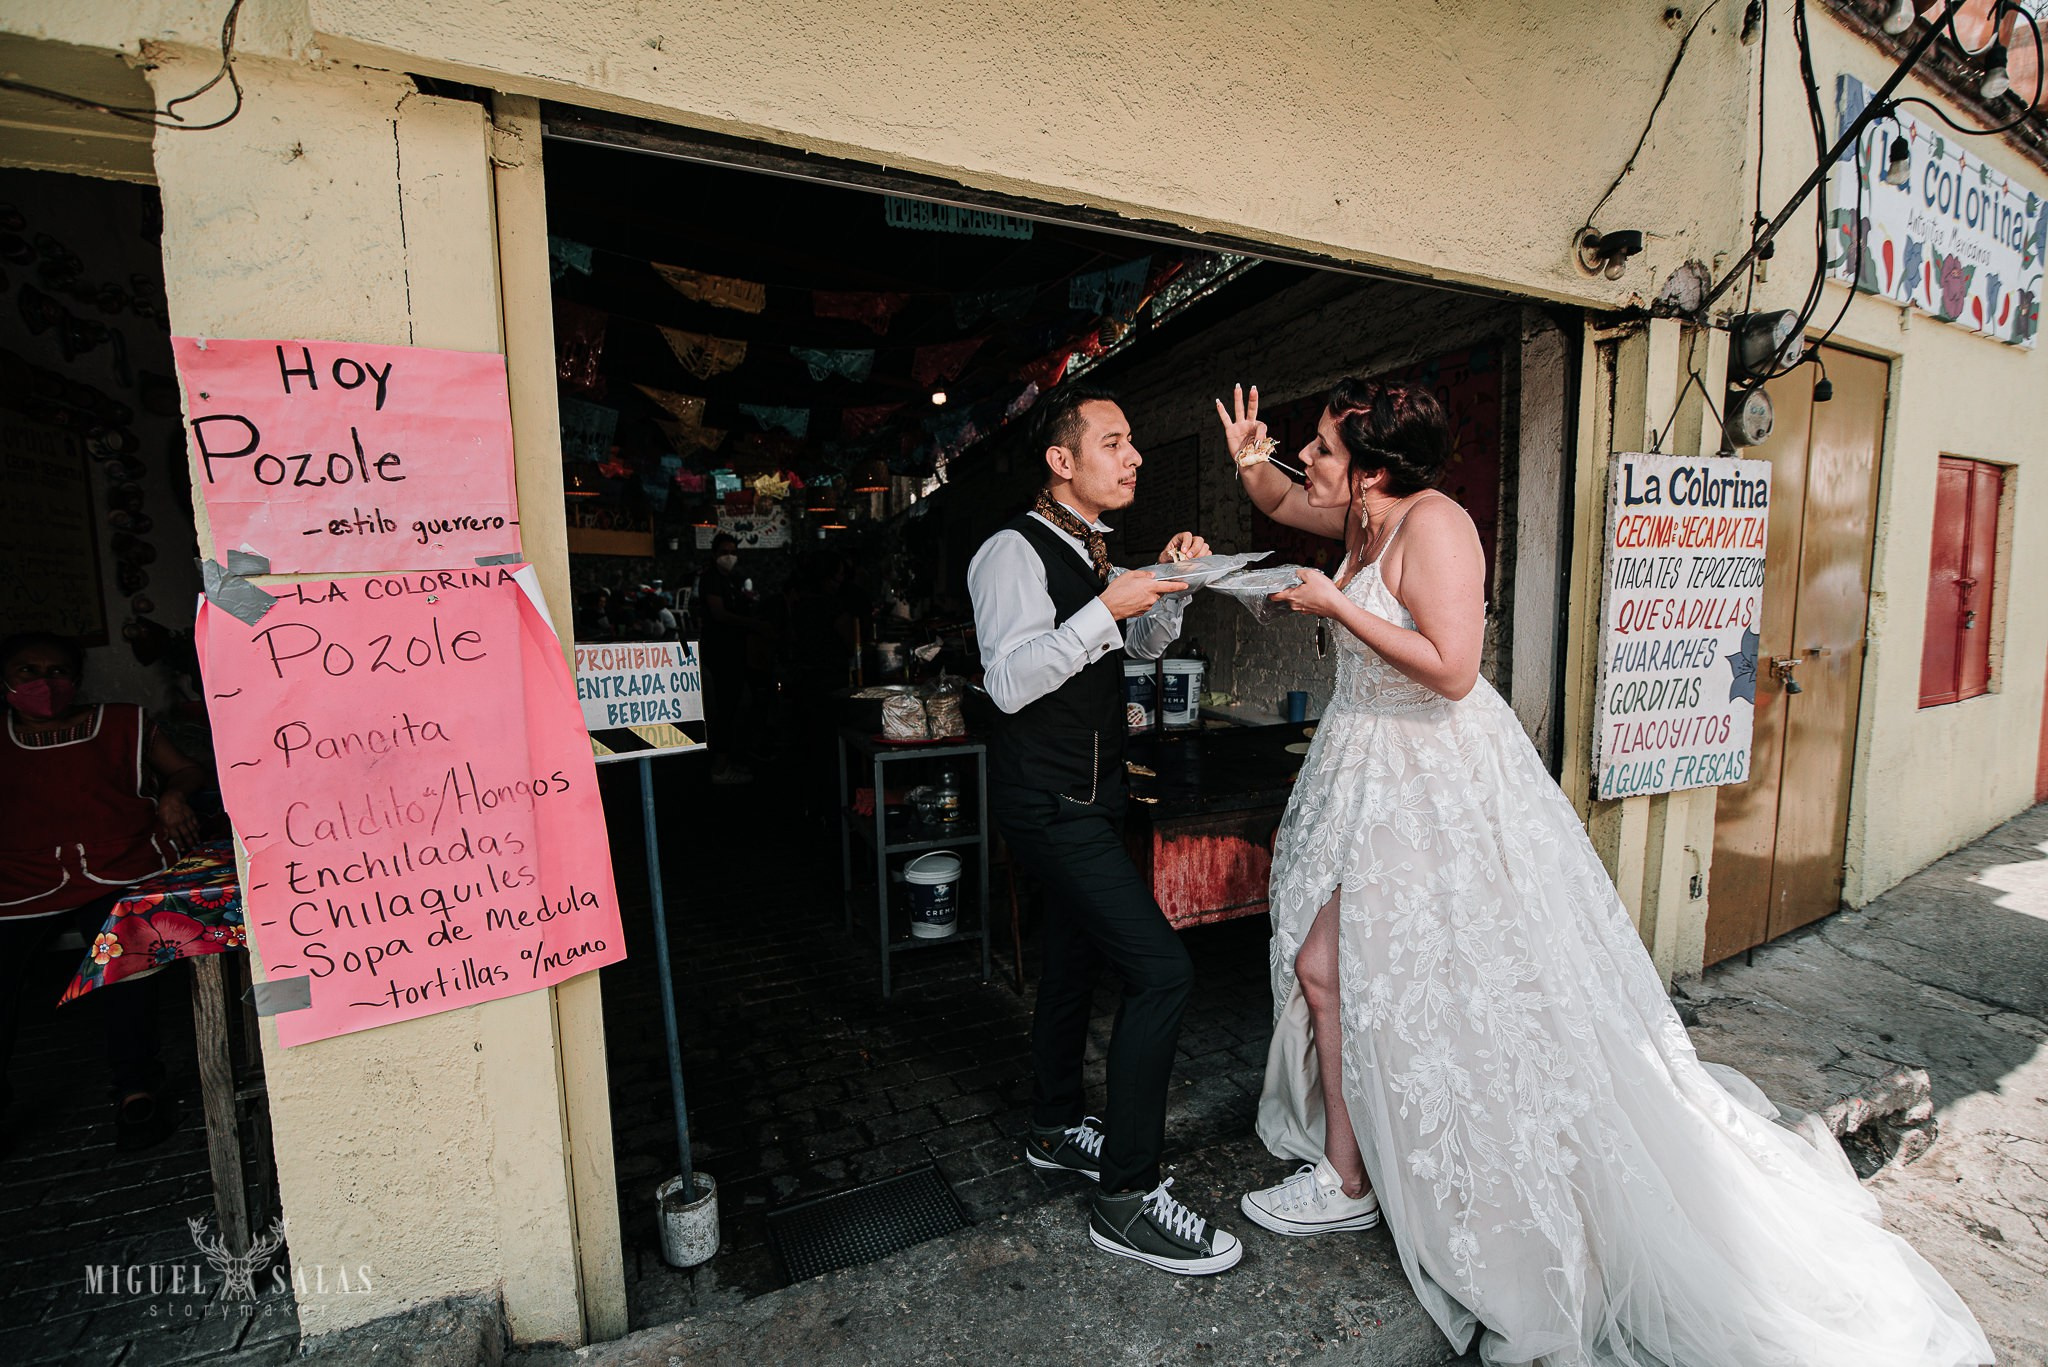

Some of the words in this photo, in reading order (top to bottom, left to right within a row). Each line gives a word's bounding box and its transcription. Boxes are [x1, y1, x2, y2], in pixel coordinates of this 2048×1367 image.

[276, 345, 393, 411] Hoy
[190, 414, 407, 486] Pozole
[1624, 463, 1662, 507] La
[1669, 466, 1768, 509] Colorina
[1615, 515, 1674, 548] CECINA
[1678, 515, 1765, 549] YECAPIXTLA
[364, 568, 517, 600] COLORINA
[1615, 556, 1682, 589] ITACATES
[1687, 556, 1766, 589] TEPOZTECOS
[1615, 597, 1754, 634] QUESADILLAS
[252, 617, 486, 679] Pozole
[575, 646, 673, 671] PROHIBIDA
[677, 646, 697, 667] LA
[1612, 638, 1718, 673] HUARACHES
[577, 673, 665, 700] ENTRADA
[670, 671, 700, 693] CON
[1609, 677, 1701, 715] GORDITAS
[607, 698, 682, 725] BEBIDAS
[274, 712, 450, 768] Pancita
[1611, 714, 1731, 755] TLACOYITOS
[1601, 758, 1666, 796] AGUAS
[1670, 750, 1745, 787] FRESCAS
[286, 786, 426, 848] Caldito
[286, 828, 525, 895] Enchiladas
[289, 864, 536, 937] Chilaquiles
[302, 939, 413, 978] Sopa
[427, 920, 472, 946] de
[486, 885, 600, 932] Medula
